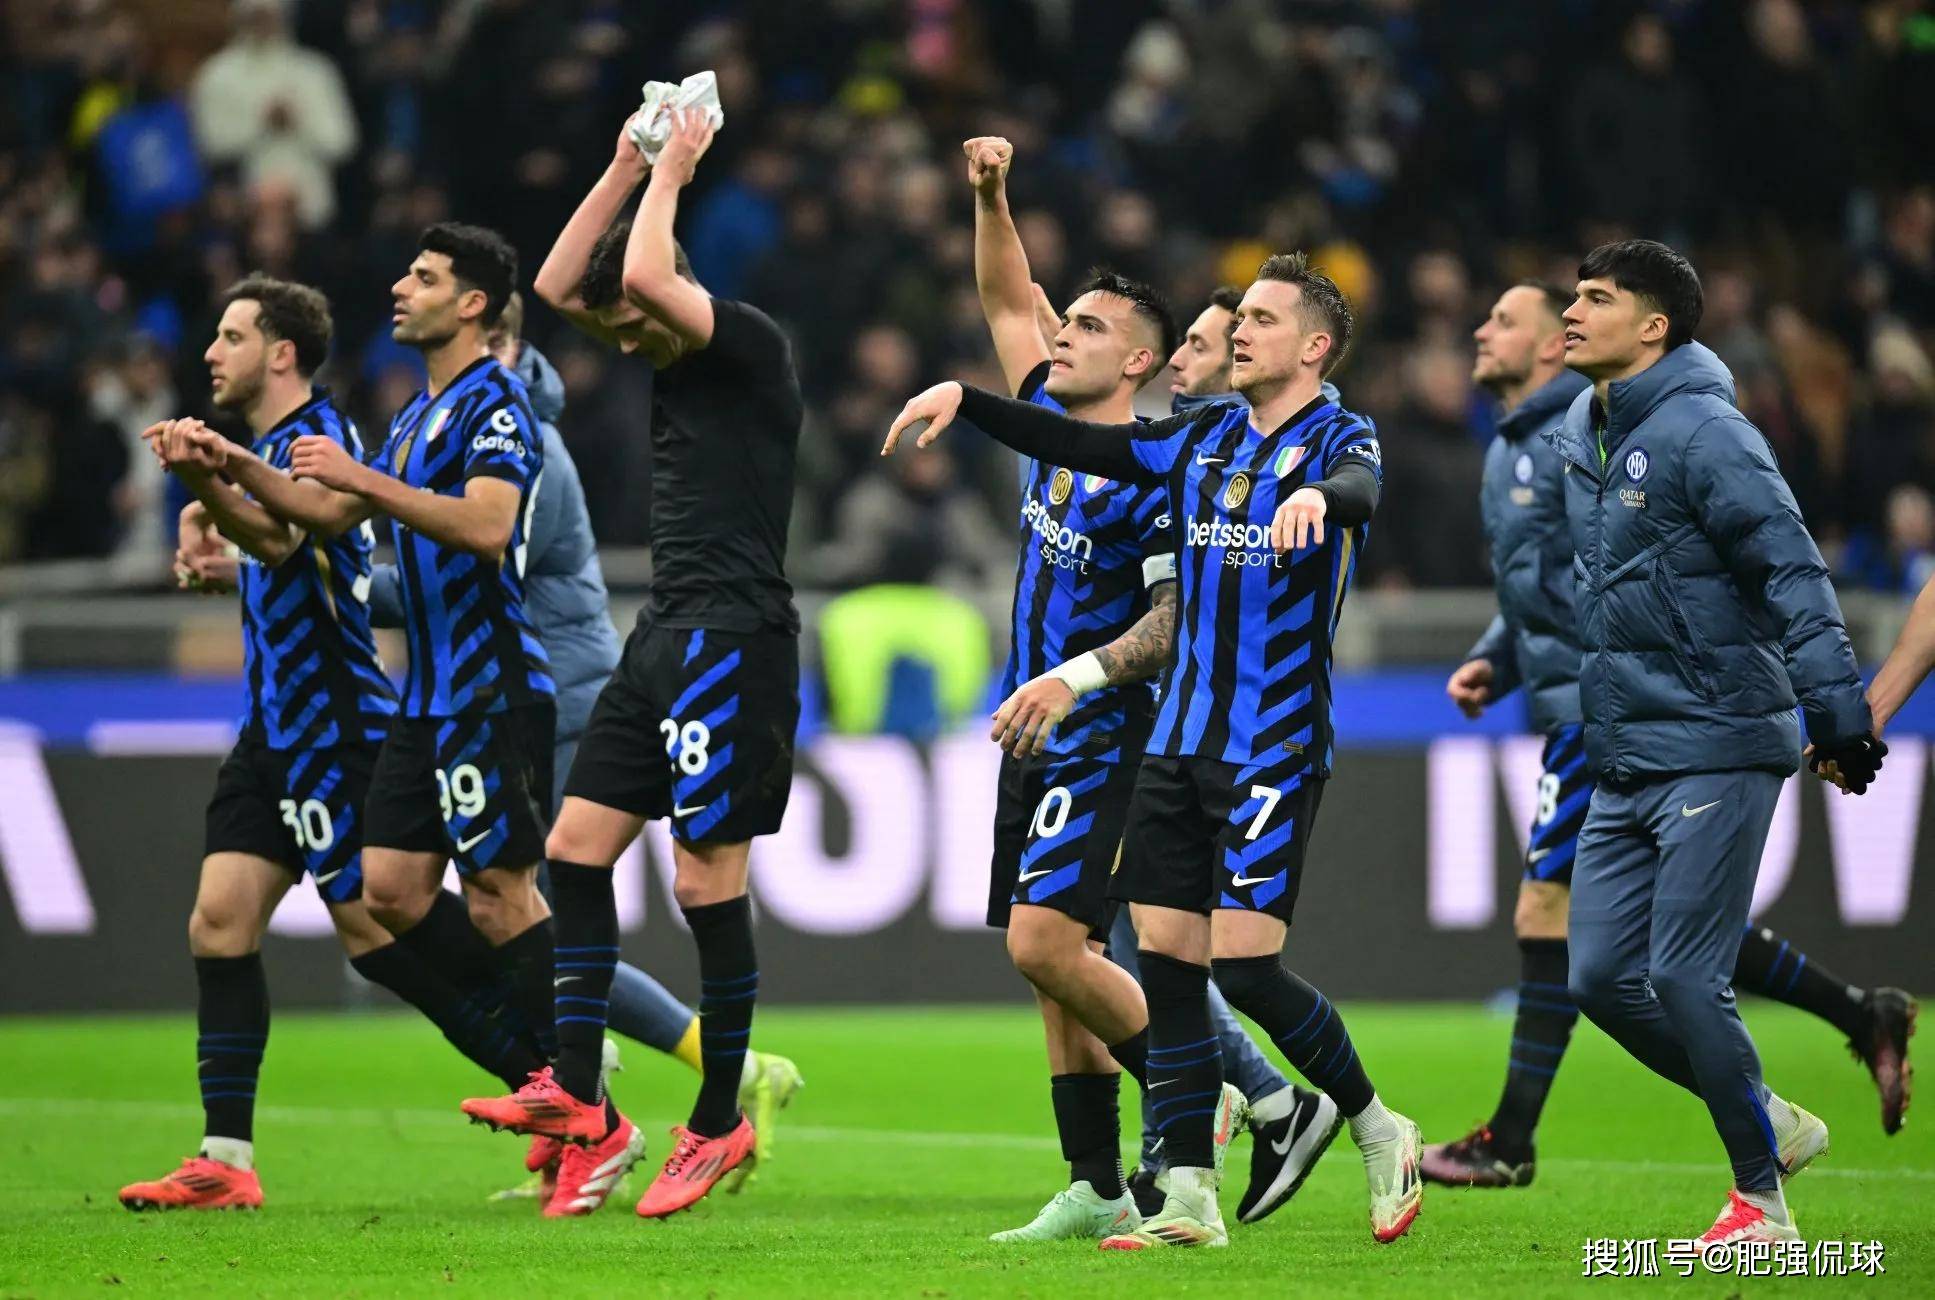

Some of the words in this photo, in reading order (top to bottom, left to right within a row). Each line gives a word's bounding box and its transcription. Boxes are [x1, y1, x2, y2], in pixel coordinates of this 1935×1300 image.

[1619, 488, 1645, 501] QATAR
[1221, 550, 1283, 568] .sport
[659, 718, 710, 776] 28
[279, 799, 334, 851] 30
[1244, 784, 1282, 840] 7
